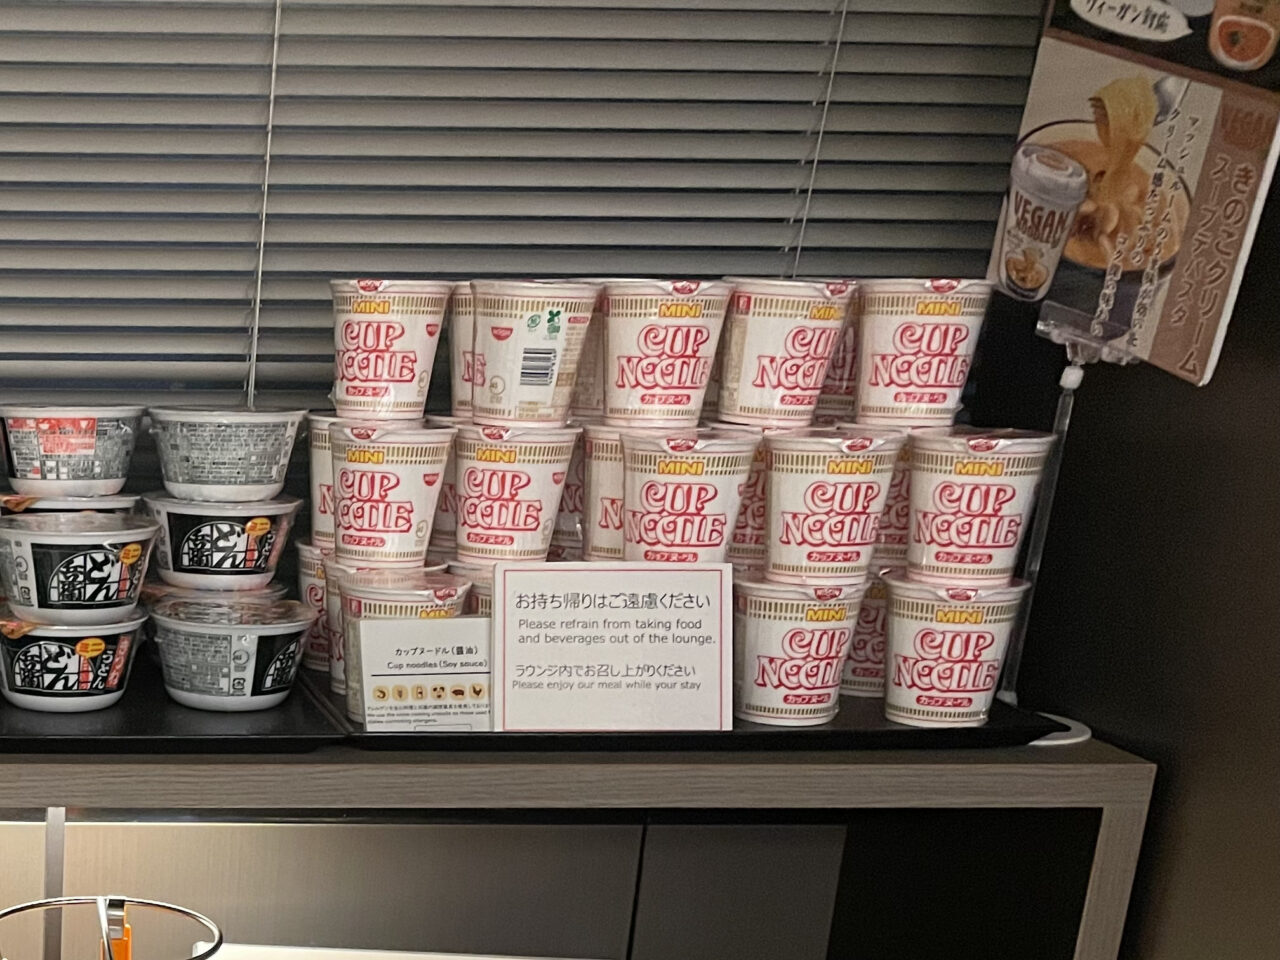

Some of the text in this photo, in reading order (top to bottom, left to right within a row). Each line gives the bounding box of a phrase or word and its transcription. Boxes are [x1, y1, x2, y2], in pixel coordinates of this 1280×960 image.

[1014, 190, 1070, 233] VEGAN
[1179, 164, 1257, 376] きのこクリーム
[352, 300, 390, 314] MINI
[659, 303, 702, 318] MINI
[916, 302, 961, 316] MINI
[341, 320, 405, 351] CUP
[637, 325, 709, 357] CUP
[893, 322, 969, 356] CUP
[347, 450, 384, 464] MINI
[476, 450, 517, 464] MINI
[657, 459, 705, 476] MINI
[827, 459, 873, 476] MINI
[954, 459, 1004, 477] MINI
[337, 468, 400, 500] CUP
[464, 467, 531, 500] CUP
[640, 481, 718, 515] CUP
[804, 481, 880, 515] CUP
[933, 480, 1016, 516] CUP
[625, 511, 727, 548] NOODLE
[914, 511, 1022, 549] NOODLE
[644, 550, 698, 563] カップヌードル
[806, 550, 860, 563] カップヌードル
[515, 593, 710, 610] お持ち帰りはご遠慮ください
[519, 619, 702, 631] Please refrain from taking food
[935, 608, 985, 625] MINI
[518, 634, 716, 646] and beverages out of the lounge.
[914, 628, 994, 662] CUP
[387, 661, 404, 670] Cup
[515, 664, 696, 678] ラウンジ内でお召し上がりください
[893, 654, 1000, 693] NOODLE
[512, 680, 544, 689] Please
[547, 680, 574, 691] enjoy
[597, 680, 621, 689] meal
[626, 680, 652, 689] while
[655, 681, 675, 690] your
[680, 681, 701, 690] stay
